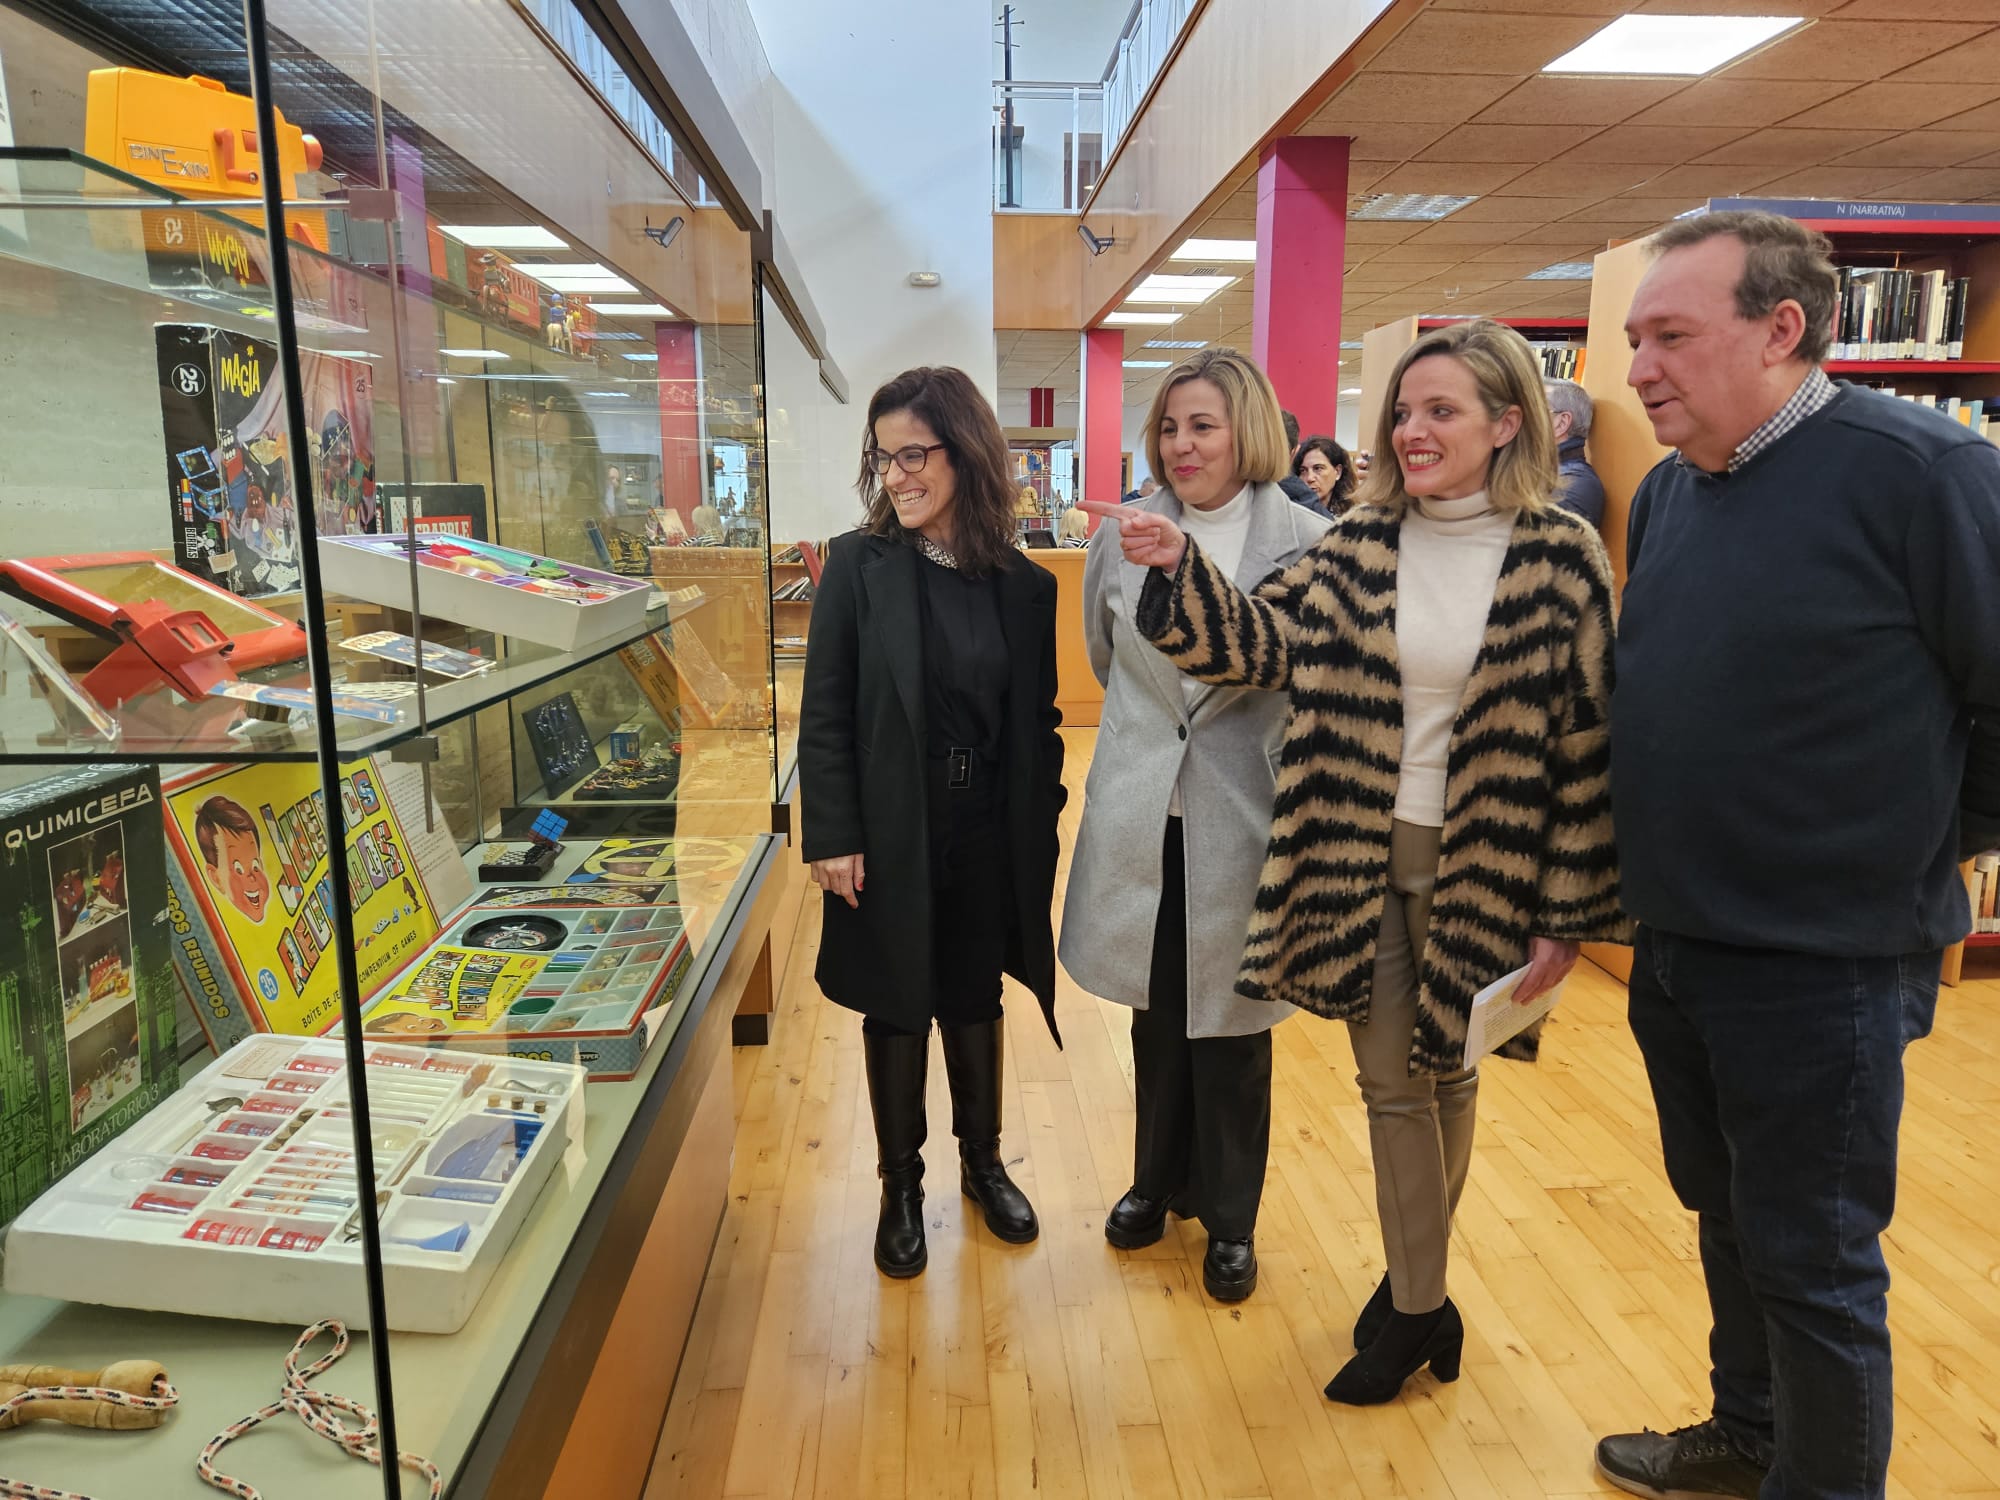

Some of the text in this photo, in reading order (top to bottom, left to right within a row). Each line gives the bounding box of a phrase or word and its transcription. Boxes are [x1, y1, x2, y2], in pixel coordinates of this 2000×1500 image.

[1836, 204, 1906, 217] N (NARRATIVA)
[180, 367, 199, 393] 25
[222, 346, 260, 398] MAGIA
[5, 783, 154, 848] QUIMICEFA
[181, 937, 231, 1019] REUNIDOS
[260, 972, 277, 998] 35
[322, 997, 332, 1011] DE
[392, 944, 399, 955] OF
[400, 930, 417, 948] GAMES
[389, 951, 467, 1010] JUEGOS
[50, 1083, 159, 1179] LABORATORIO 3
